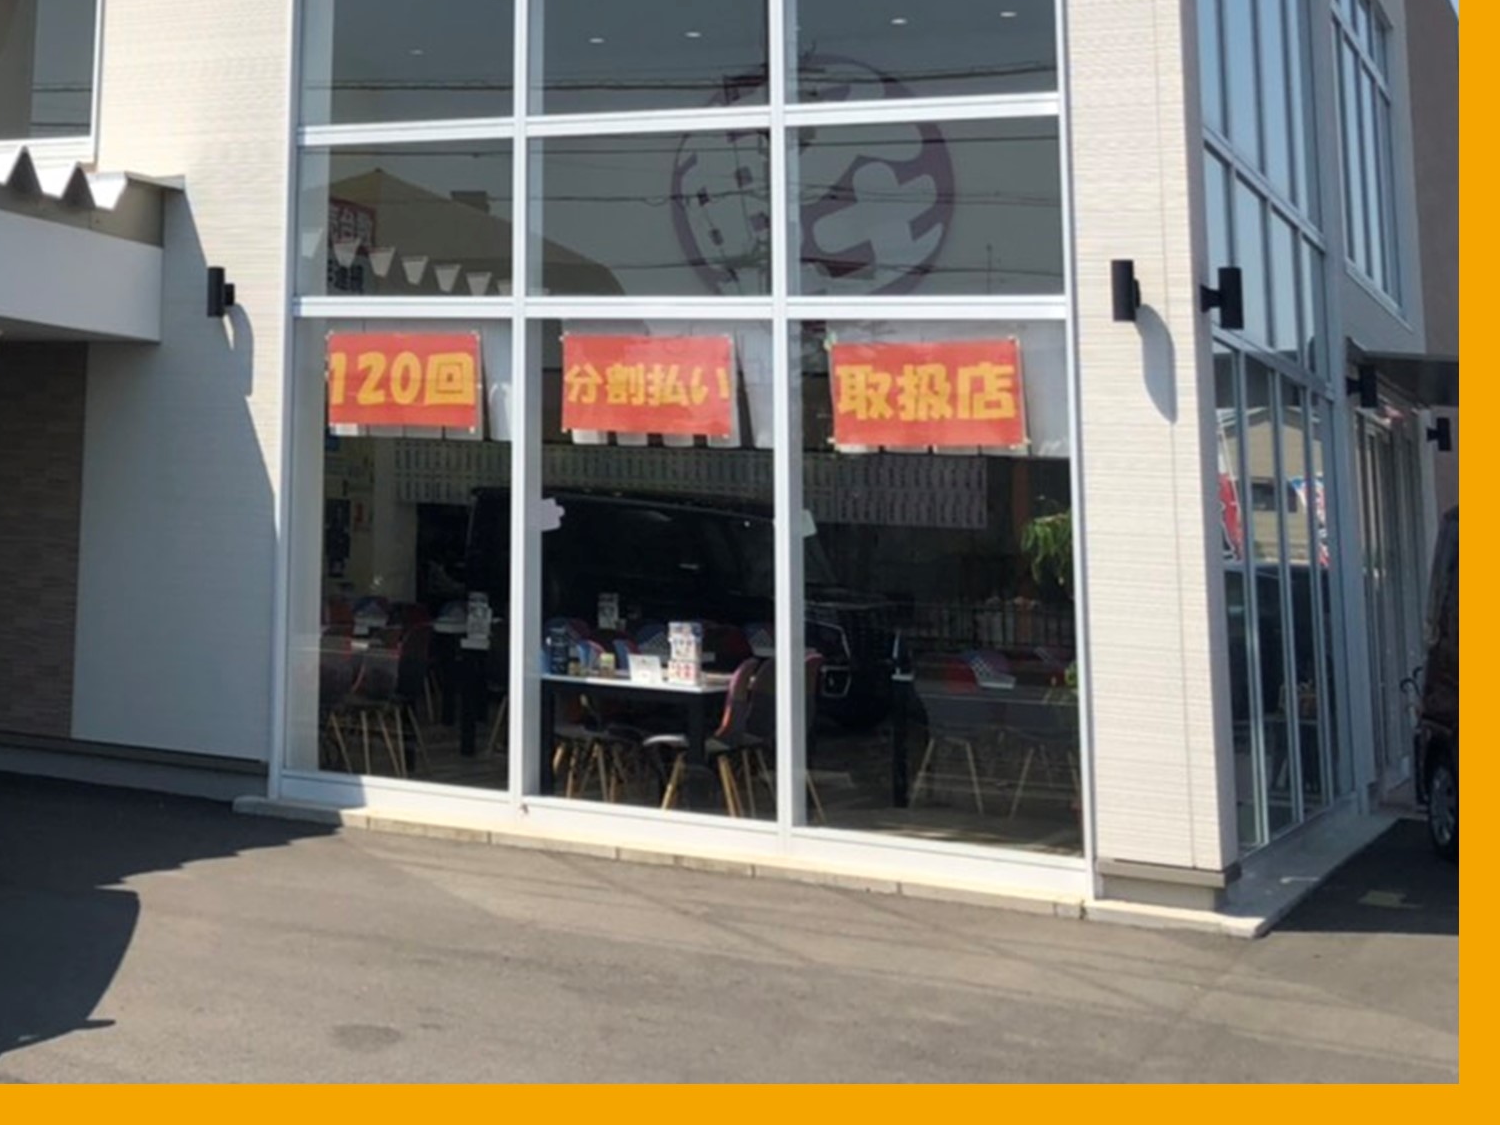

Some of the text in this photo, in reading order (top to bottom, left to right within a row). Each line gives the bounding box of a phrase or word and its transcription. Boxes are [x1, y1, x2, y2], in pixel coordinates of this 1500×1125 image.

[330, 350, 476, 406] 120回
[565, 361, 730, 407] 分割払い
[835, 361, 1016, 421] 取扱店
